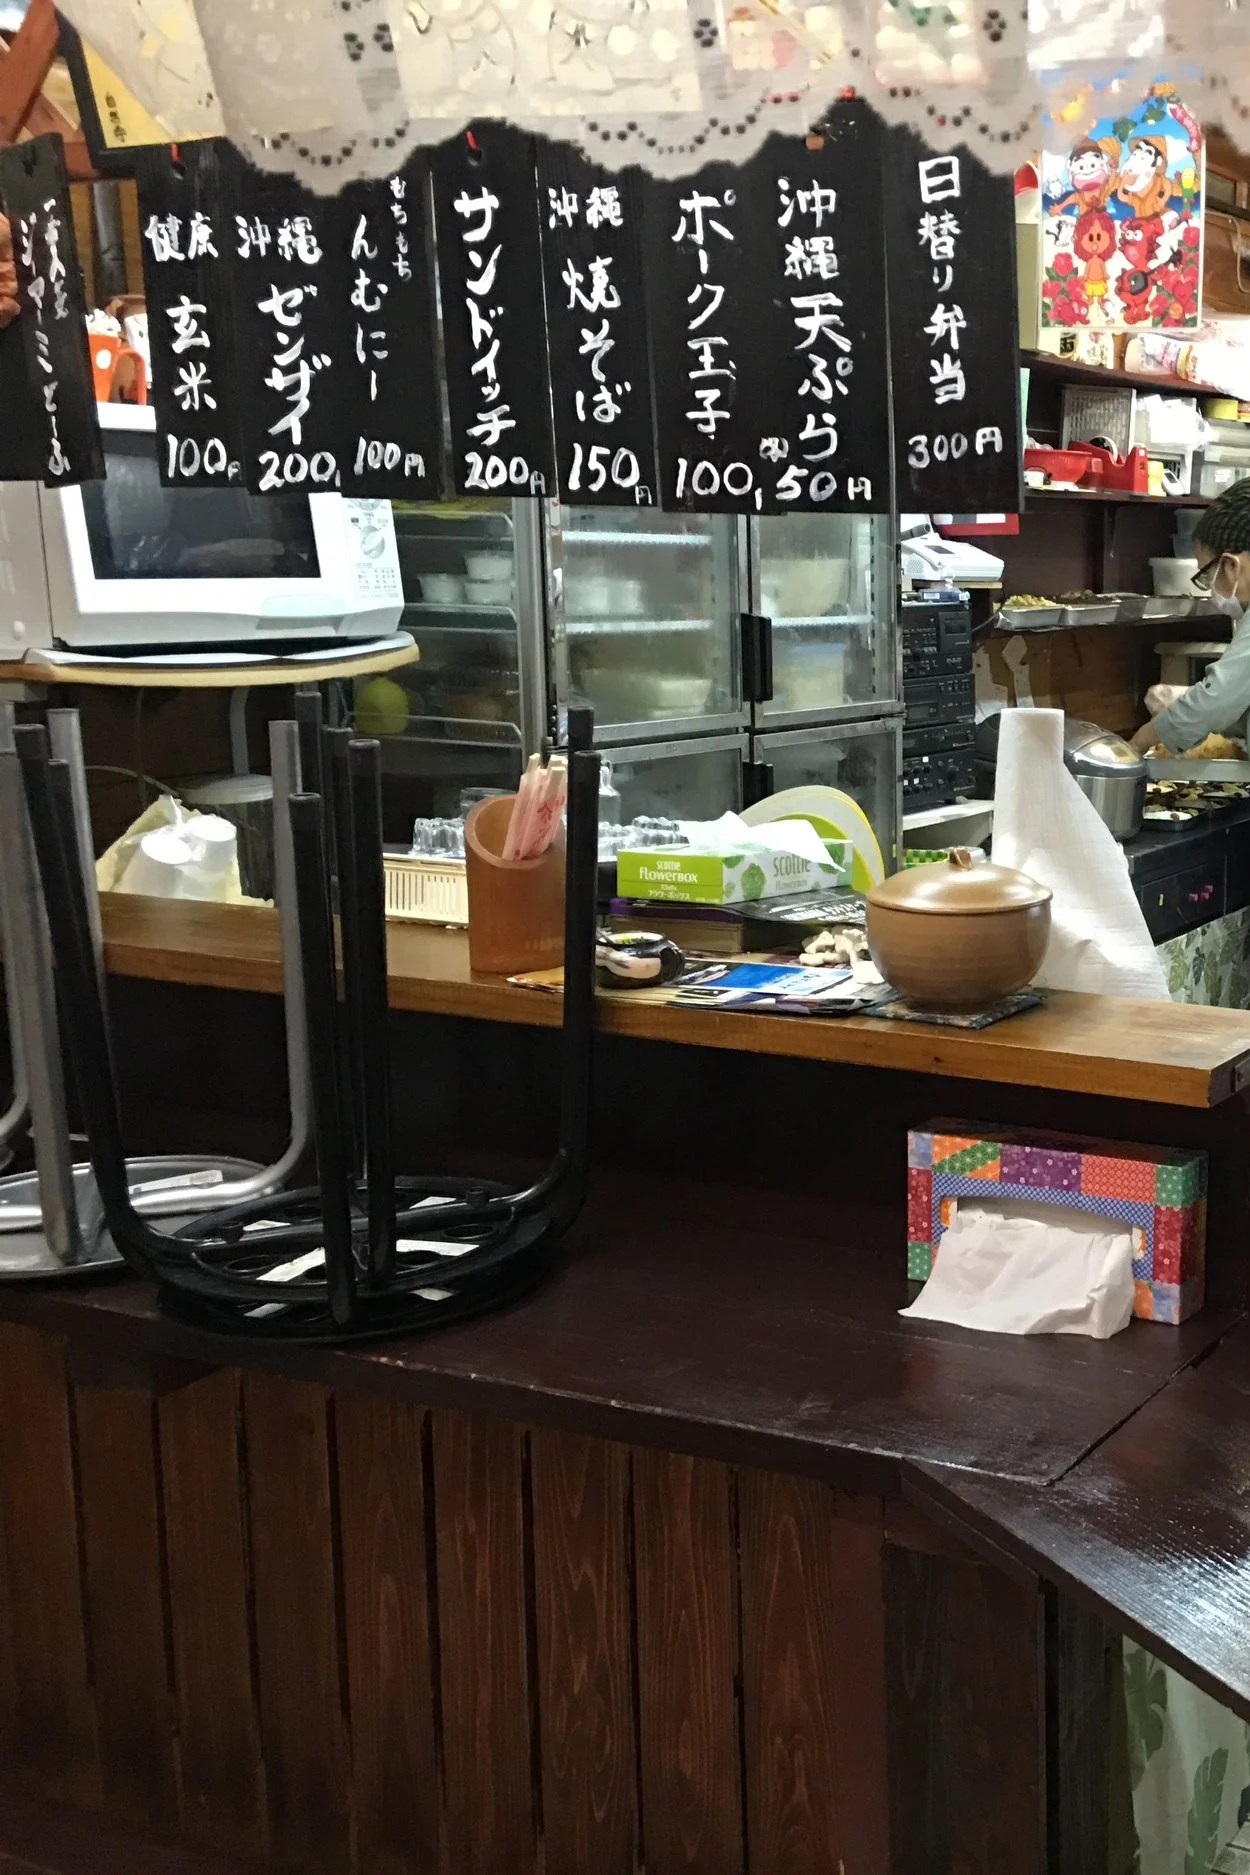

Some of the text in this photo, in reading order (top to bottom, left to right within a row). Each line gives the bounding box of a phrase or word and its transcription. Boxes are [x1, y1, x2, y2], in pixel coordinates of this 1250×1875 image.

[145, 211, 219, 262] 健康
[235, 214, 324, 264] 沖縄
[390, 175, 412, 282] もちもち
[548, 186, 625, 228] 沖縄
[351, 214, 389, 401] んむにー
[454, 186, 517, 447] サンドイッチ
[671, 187, 738, 440] ポーク玉子
[777, 177, 854, 462] 沖縄天ぷら
[917, 155, 968, 405] 日替り弁当
[166, 295, 218, 411] 玄米
[258, 283, 332, 445] ゼンザイ
[562, 255, 631, 423] 焼そば
[353, 436, 425, 478] 100円
[464, 452, 546, 495] 200円
[568, 442, 653, 505] 150円
[776, 464, 872, 502] 50円
[907, 426, 1003, 469] 300円
